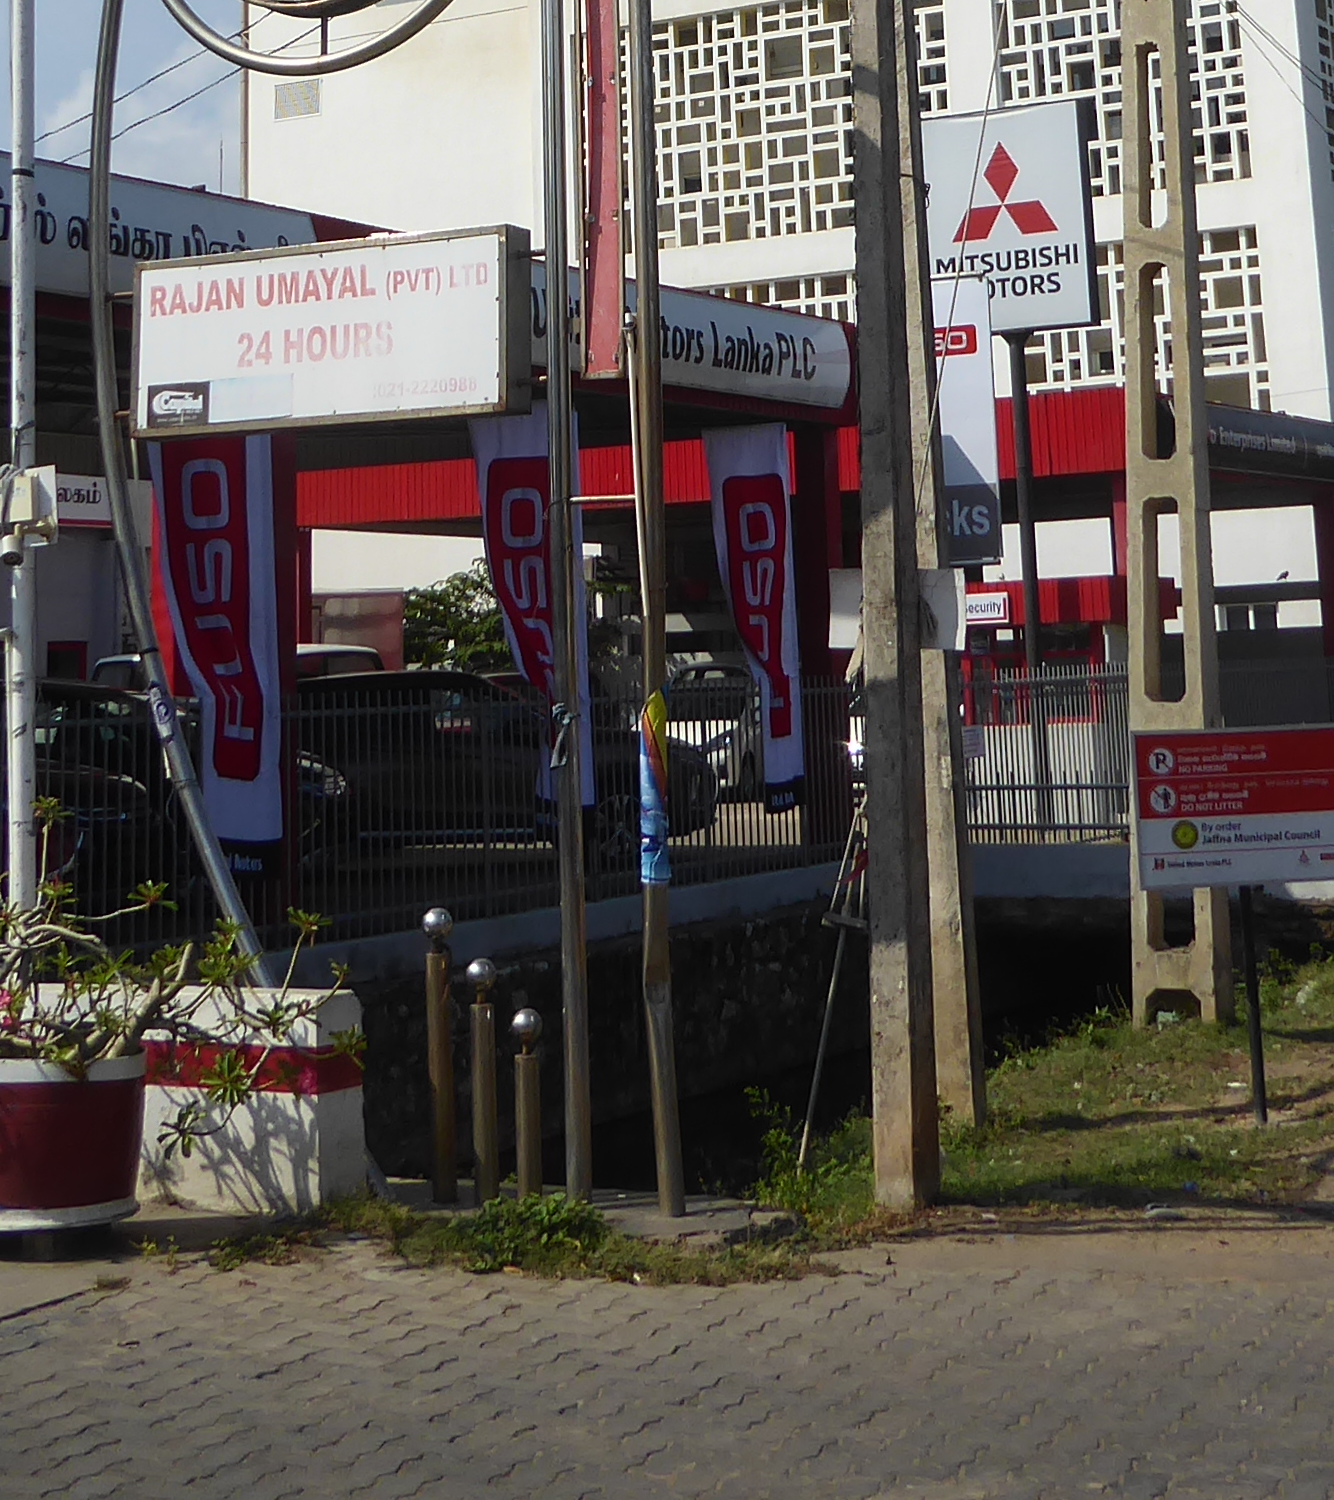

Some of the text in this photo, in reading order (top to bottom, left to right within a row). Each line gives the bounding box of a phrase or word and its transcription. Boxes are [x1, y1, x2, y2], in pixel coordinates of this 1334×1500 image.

[935, 243, 1079, 274] MITSUBISHI
[150, 262, 488, 317] RAJAN UMAYAL (PVT) LTD
[988, 272, 1061, 299] TORS
[237, 321, 394, 368] 24 HOURS
[710, 320, 774, 376] Lanka
[775, 331, 818, 381] PLC
[181, 458, 255, 741] FUSO
[501, 487, 554, 697] USO
[1181, 801, 1243, 812] DO NOT LITTER
[1201, 821, 1241, 834] By order
[1202, 829, 1321, 845] Jaffna Municipal Council
